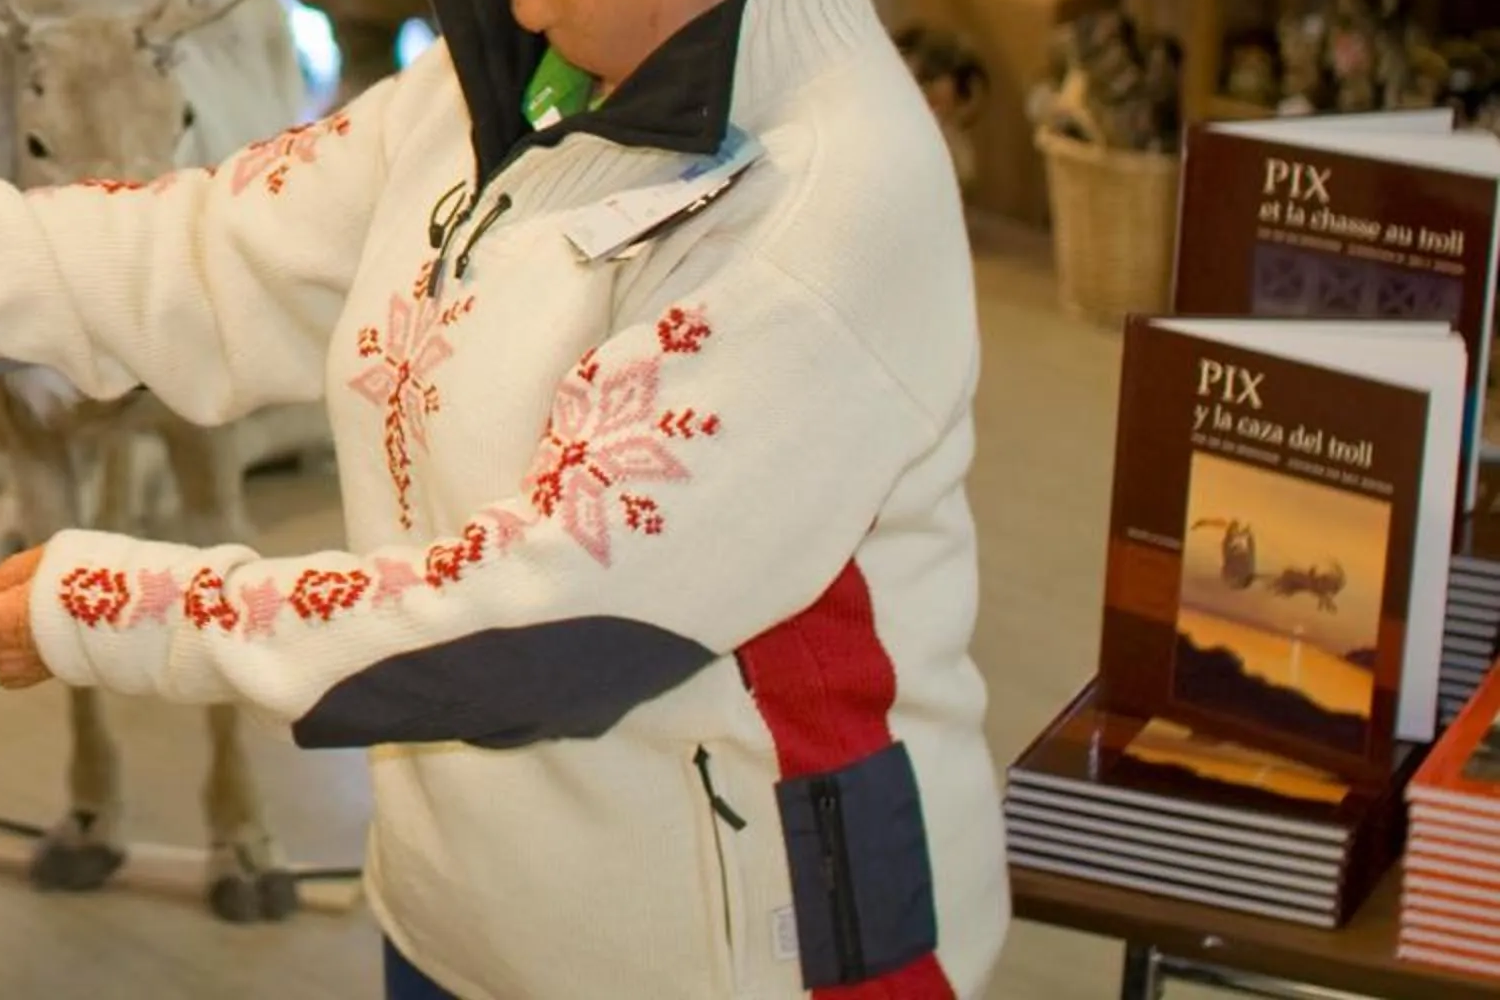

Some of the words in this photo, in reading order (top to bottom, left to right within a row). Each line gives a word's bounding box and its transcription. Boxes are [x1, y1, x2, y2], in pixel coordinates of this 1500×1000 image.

[1262, 157, 1332, 203] PIX
[1258, 200, 1281, 223] et
[1285, 200, 1306, 227] la
[1309, 207, 1382, 242] chasse
[1383, 223, 1413, 247] au
[1417, 227, 1465, 257] troll
[1196, 358, 1265, 410] PIX
[1192, 403, 1209, 430] y
[1213, 403, 1233, 431] la
[1236, 415, 1285, 446] caza
[1288, 423, 1323, 455] del
[1328, 436, 1374, 470] troll
